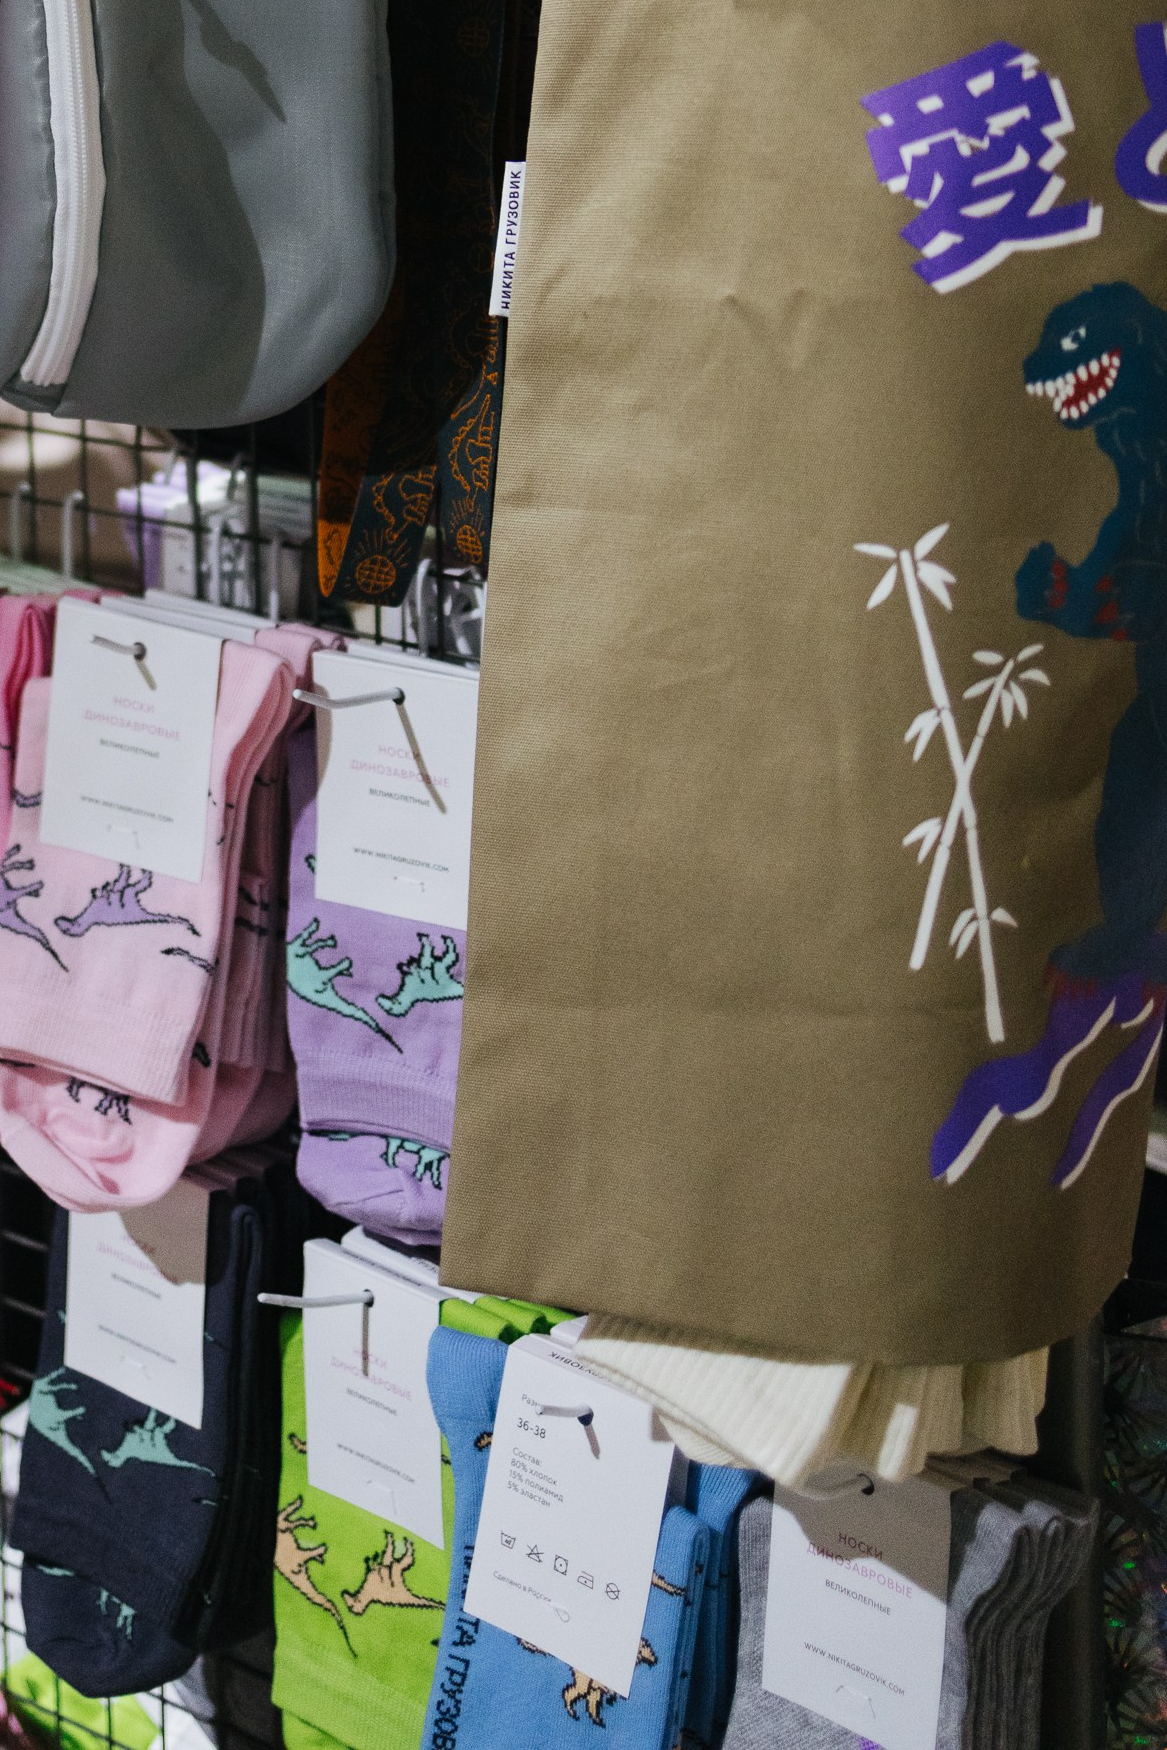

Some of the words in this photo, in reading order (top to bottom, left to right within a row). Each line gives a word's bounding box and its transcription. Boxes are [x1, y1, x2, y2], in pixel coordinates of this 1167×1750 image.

[505, 171, 521, 245] ГРУЗОВИК
[501, 251, 516, 310] НИКИТА
[113, 696, 155, 713] НОСКИ
[83, 708, 181, 741] ДИНОЗАВРОВЫЕ
[350, 759, 450, 788] ДИНОЗАВРОВЫЕ
[516, 1417, 546, 1440] 36-38
[512, 1446, 543, 1467] Состав:
[509, 1469, 525, 1484] 15%
[525, 1477, 564, 1503] полиамид
[510, 1458, 528, 1473] 80%
[529, 1467, 558, 1486] хлопок
[507, 1481, 520, 1494] 5%
[520, 1486, 551, 1508] эластан
[838, 1532, 883, 1560] НОСКИ
[492, 1570, 522, 1589] Сделано
[807, 1541, 913, 1599] ДИНОЗАВРОВЫЕ
[825, 1578, 892, 1616] ВЕЛИКОЛЕПНЫЕ
[804, 1642, 906, 1697] WWW.NIKITAGRUZOVIK.COM
